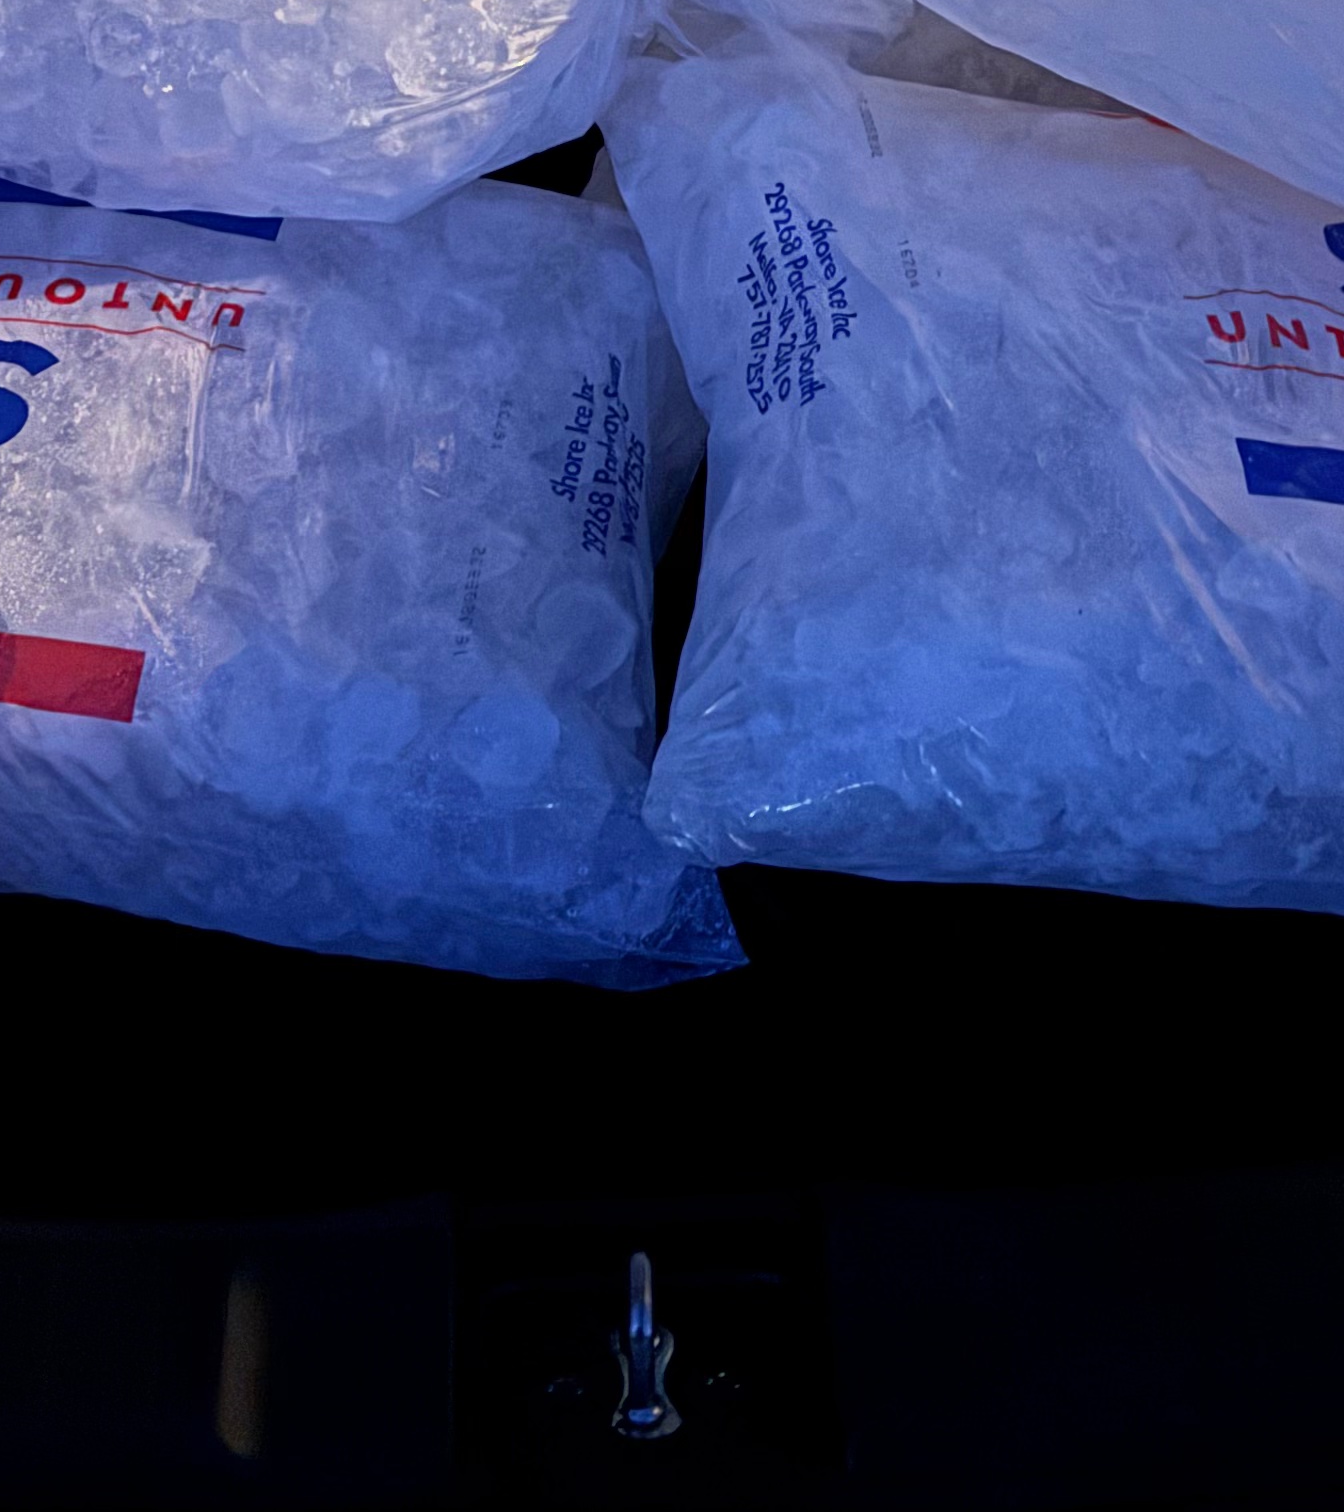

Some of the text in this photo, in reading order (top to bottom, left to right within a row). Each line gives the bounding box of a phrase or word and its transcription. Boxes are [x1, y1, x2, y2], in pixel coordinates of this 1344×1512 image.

[764, 182, 826, 407] 29268 Parkway South
[807, 218, 857, 340] Shore Ice Inc
[778, 295, 795, 339] VA
[565, 404, 594, 435] Ice
[550, 439, 586, 504] Shore
[581, 491, 616, 558] 29268
